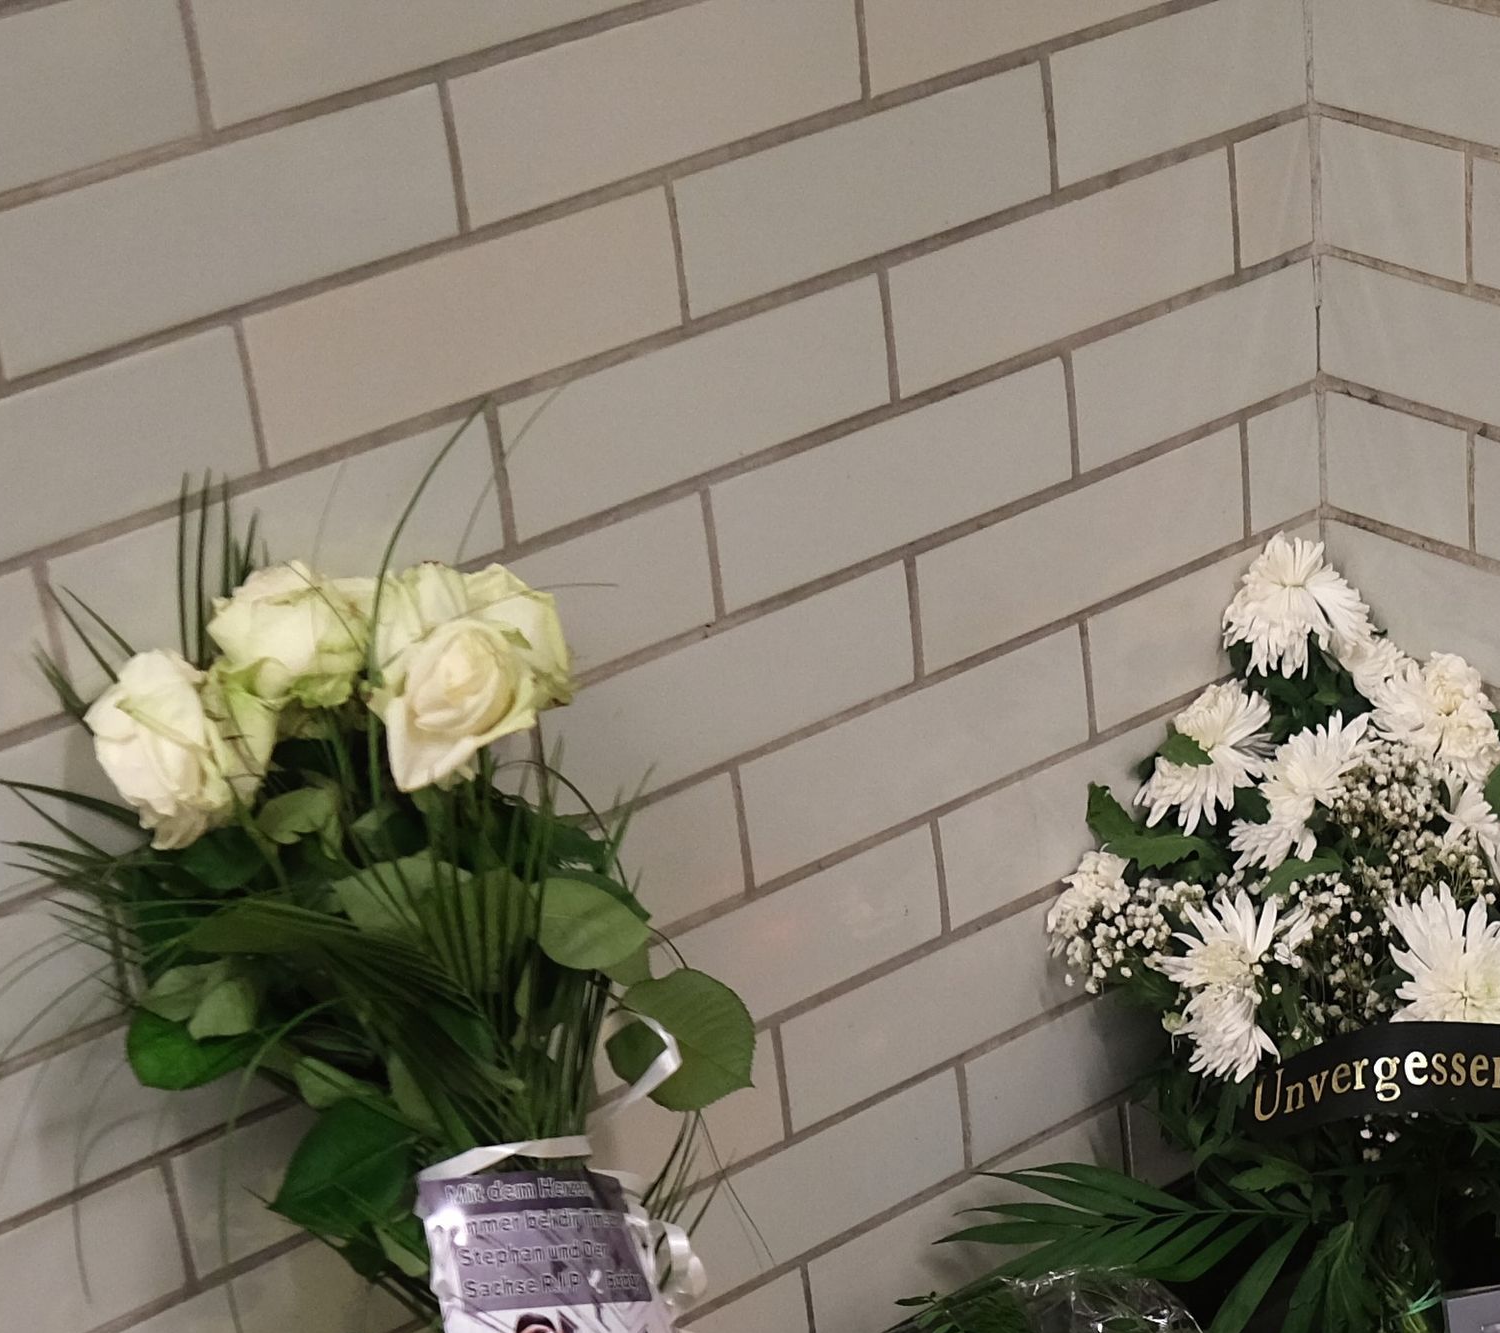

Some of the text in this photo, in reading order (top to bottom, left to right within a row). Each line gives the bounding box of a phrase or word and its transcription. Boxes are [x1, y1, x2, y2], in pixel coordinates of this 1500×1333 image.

[487, 1180, 536, 1201] dem
[459, 1245, 545, 1267] Stephan
[549, 1240, 581, 1260] und
[463, 1277, 538, 1298] Sachse
